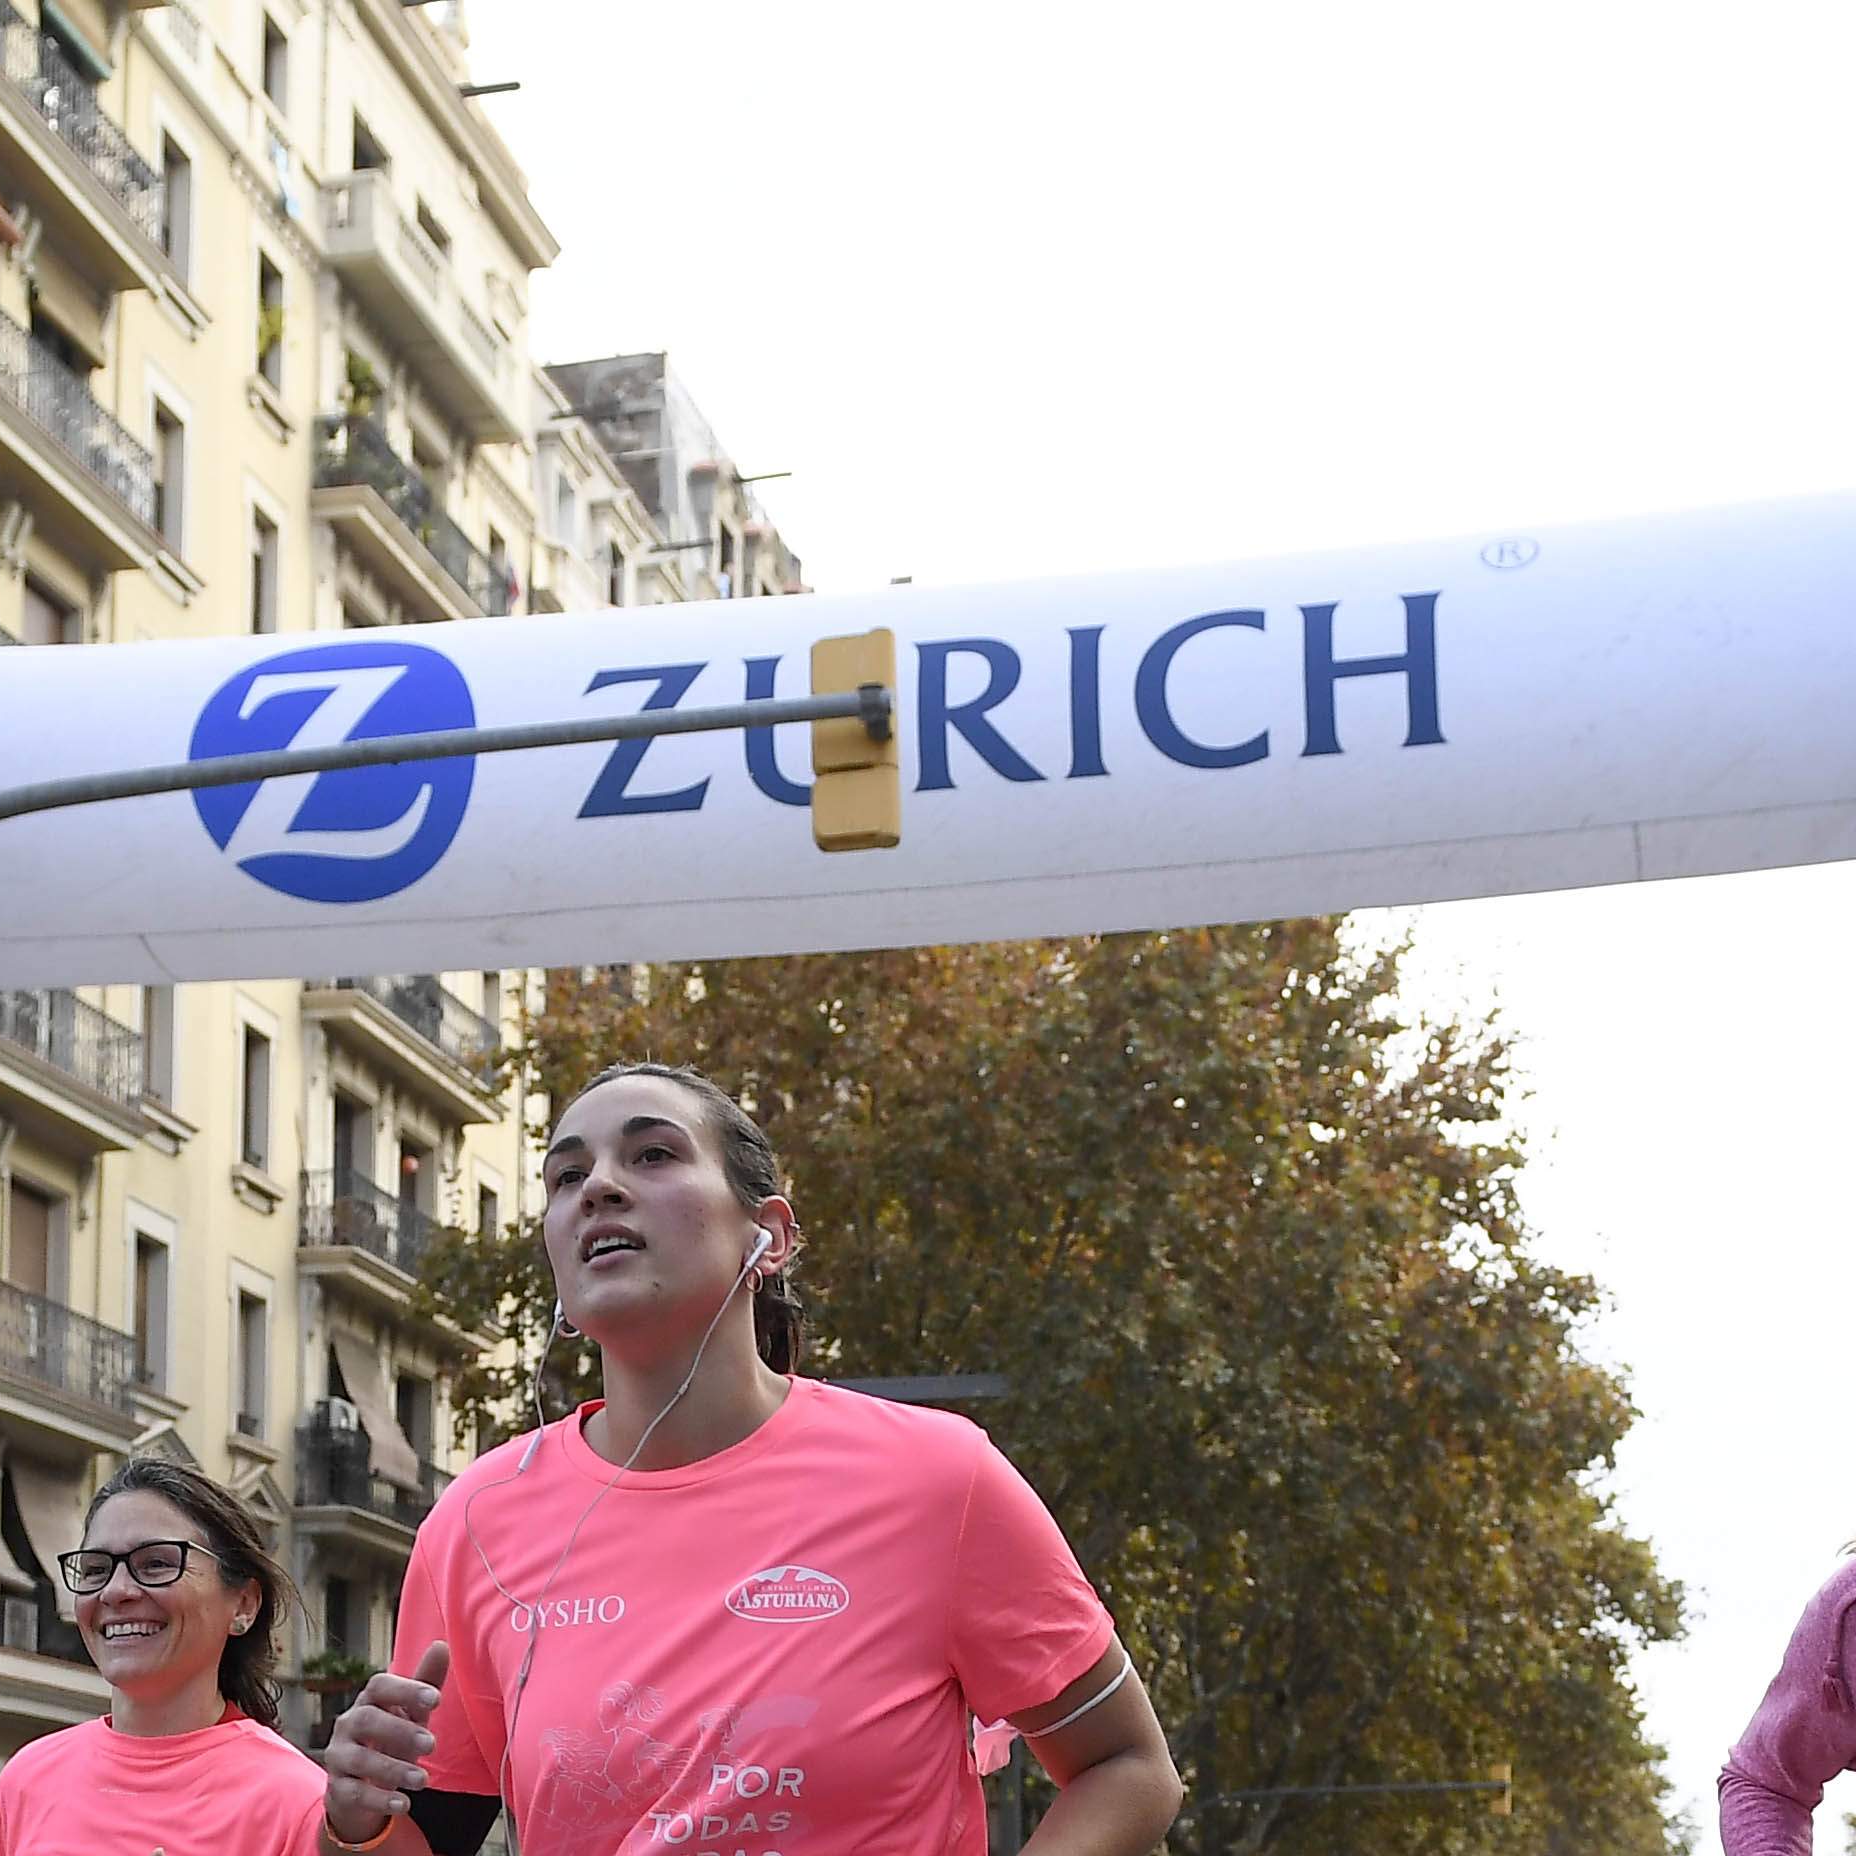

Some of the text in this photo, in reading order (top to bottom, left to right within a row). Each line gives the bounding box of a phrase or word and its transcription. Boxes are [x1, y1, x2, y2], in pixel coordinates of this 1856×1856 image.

[511, 1595, 625, 1632] OYSHO
[708, 1763, 805, 1798] POR
[648, 1811, 792, 1844] TODAS
